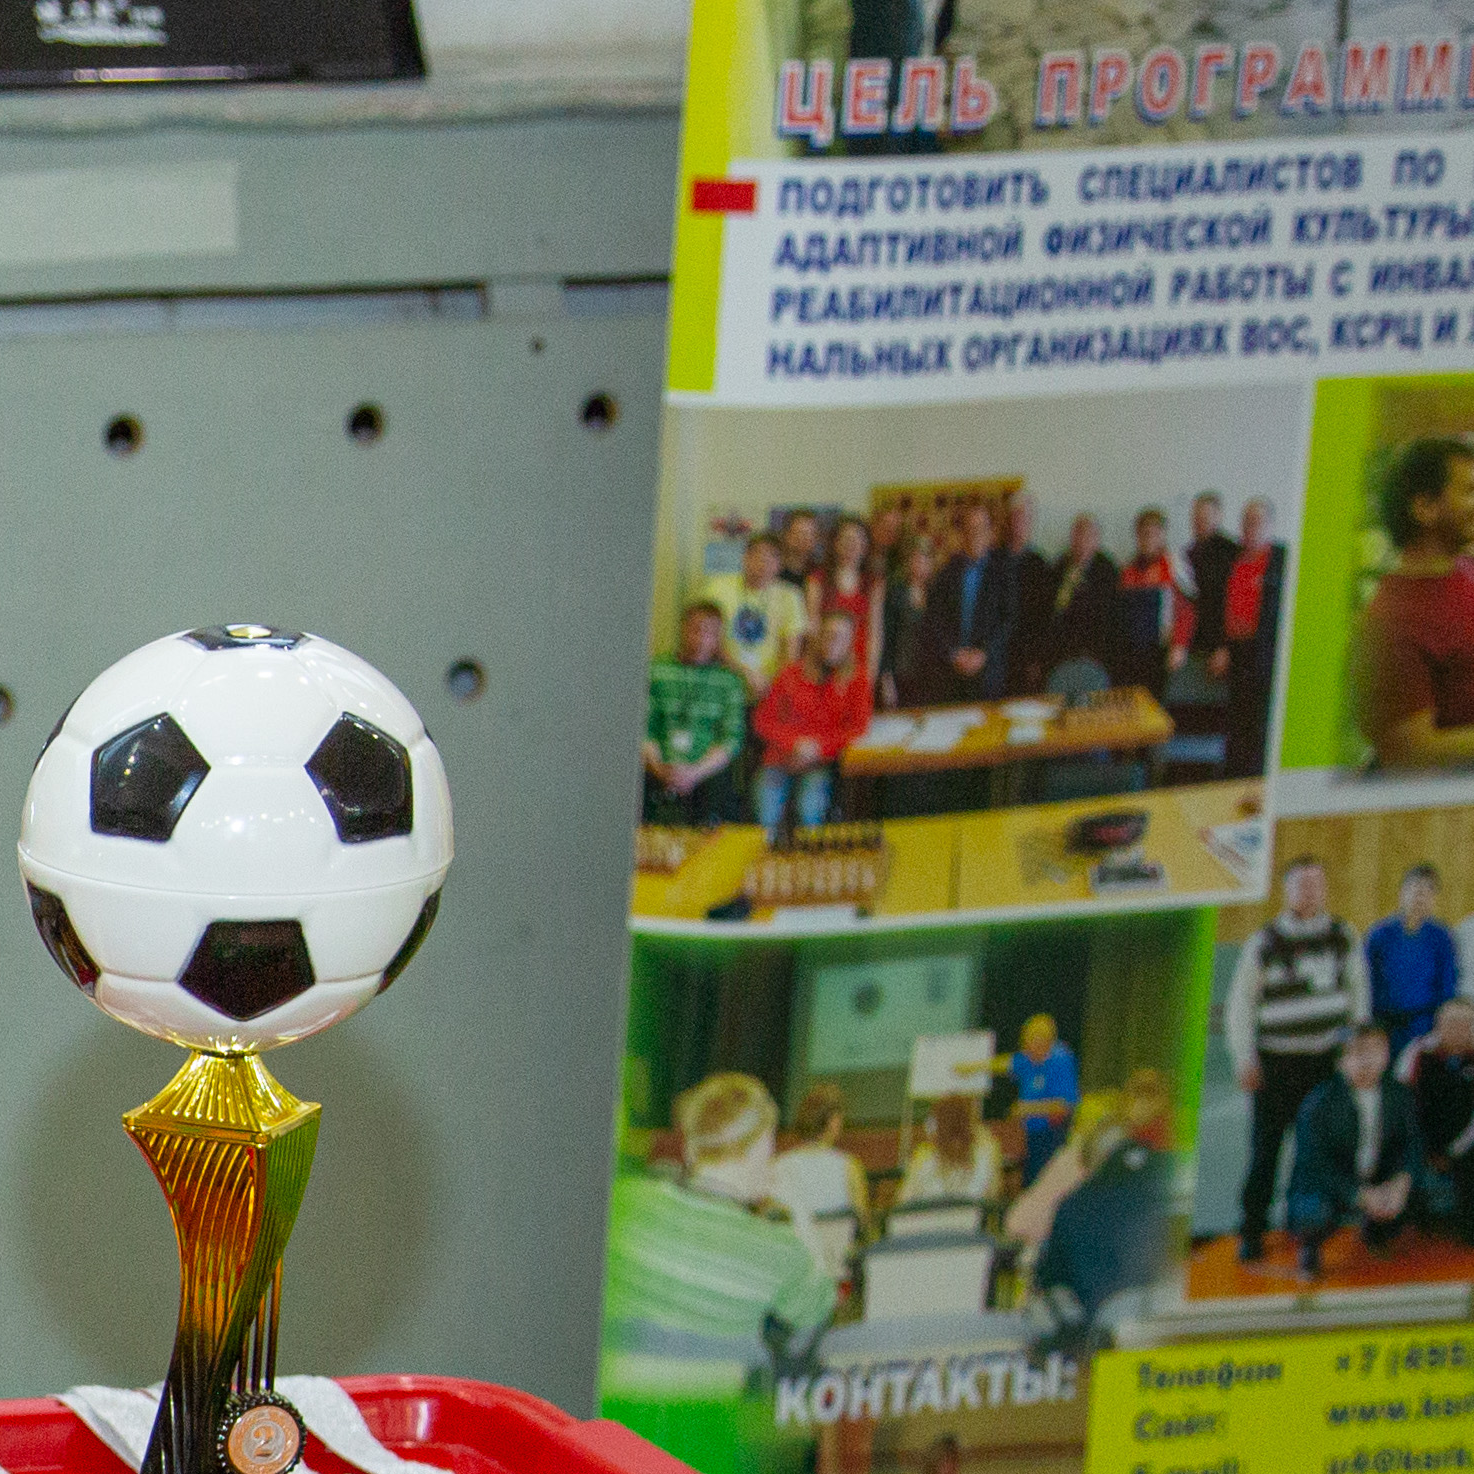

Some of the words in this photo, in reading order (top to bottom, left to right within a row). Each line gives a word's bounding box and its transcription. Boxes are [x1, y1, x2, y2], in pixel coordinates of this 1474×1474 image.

[776, 56, 998, 152] ЦЕЛЬ
[1034, 40, 1474, 133] ПРОГРАММ
[778, 168, 1050, 219] ПОДГОТОВИТЬ
[1077, 152, 1361, 202] СПЕЦИАЛИСТОВ
[1392, 149, 1446, 190] ПО
[775, 214, 1024, 274] АДАПТИВНОЙ
[1044, 204, 1272, 258] ФИЗИЧЕСКОЙ
[769, 261, 1154, 323] РЕАБИЛИТАЦИОННОЙ
[1169, 261, 1315, 306] РАБОТЫ
[1327, 259, 1354, 297] С
[765, 336, 951, 378] НАЛЬНЫХ
[962, 320, 1228, 373] ОРГАНИЗАЦИЯХ
[1239, 313, 1320, 358] ВОС,
[776, 1350, 1079, 1426] КОНТАКТЫ:
